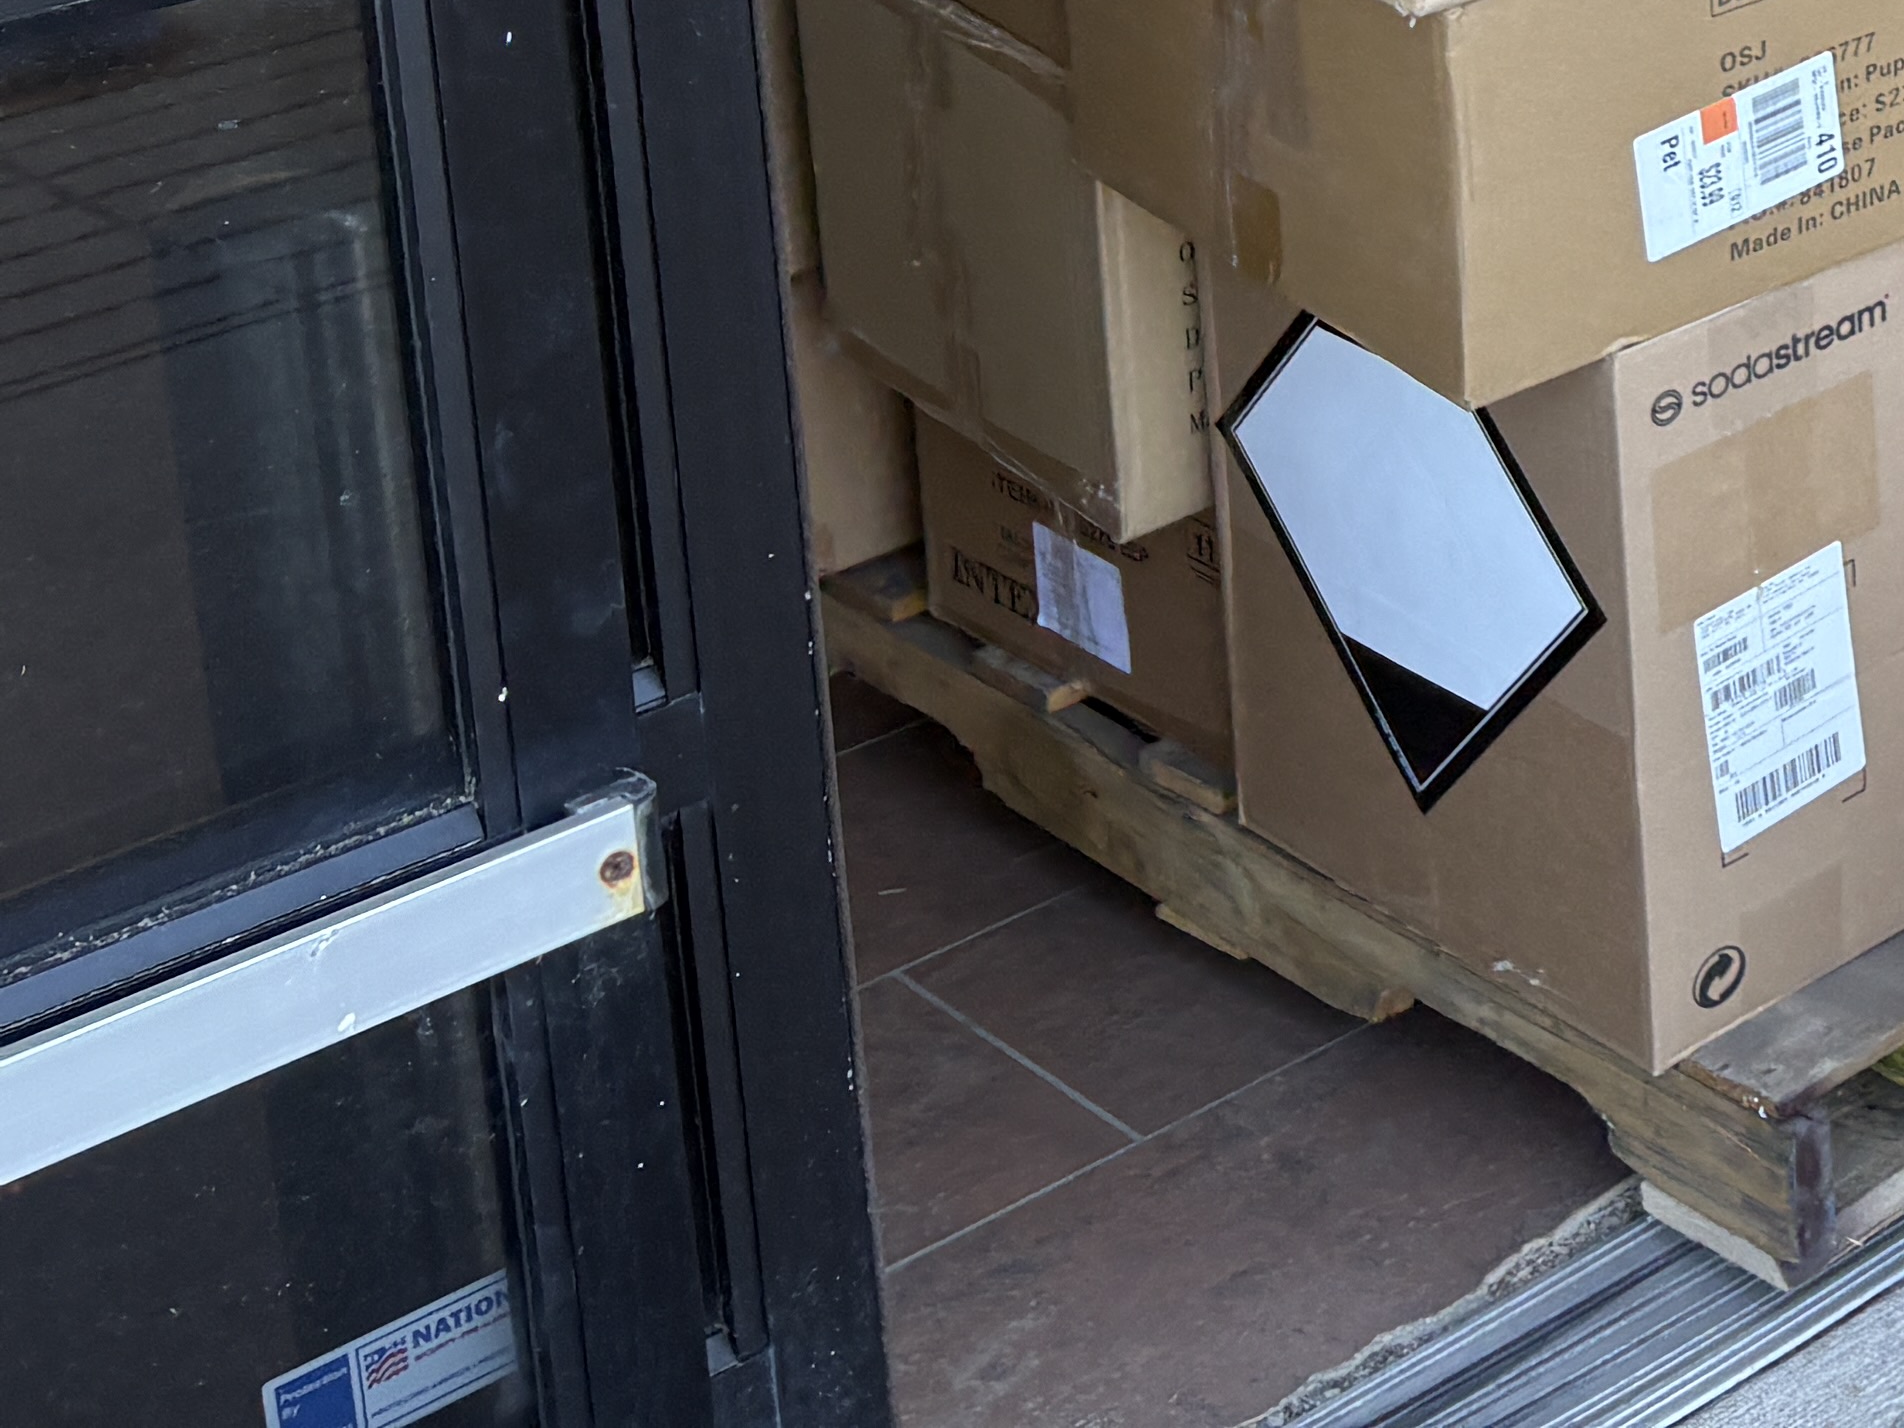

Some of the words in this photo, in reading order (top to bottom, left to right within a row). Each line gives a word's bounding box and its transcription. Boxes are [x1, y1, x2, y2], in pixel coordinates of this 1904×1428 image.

[1720, 41, 1768, 73] OSJ
[1659, 134, 1682, 173] Pet
[1815, 132, 1839, 174] 410
[1730, 228, 1792, 263] Made
[1797, 209, 1826, 235] In:
[1830, 179, 1902, 222] CHINA
[1691, 298, 1888, 408] sodastream
[412, 1289, 510, 1349] NATION
